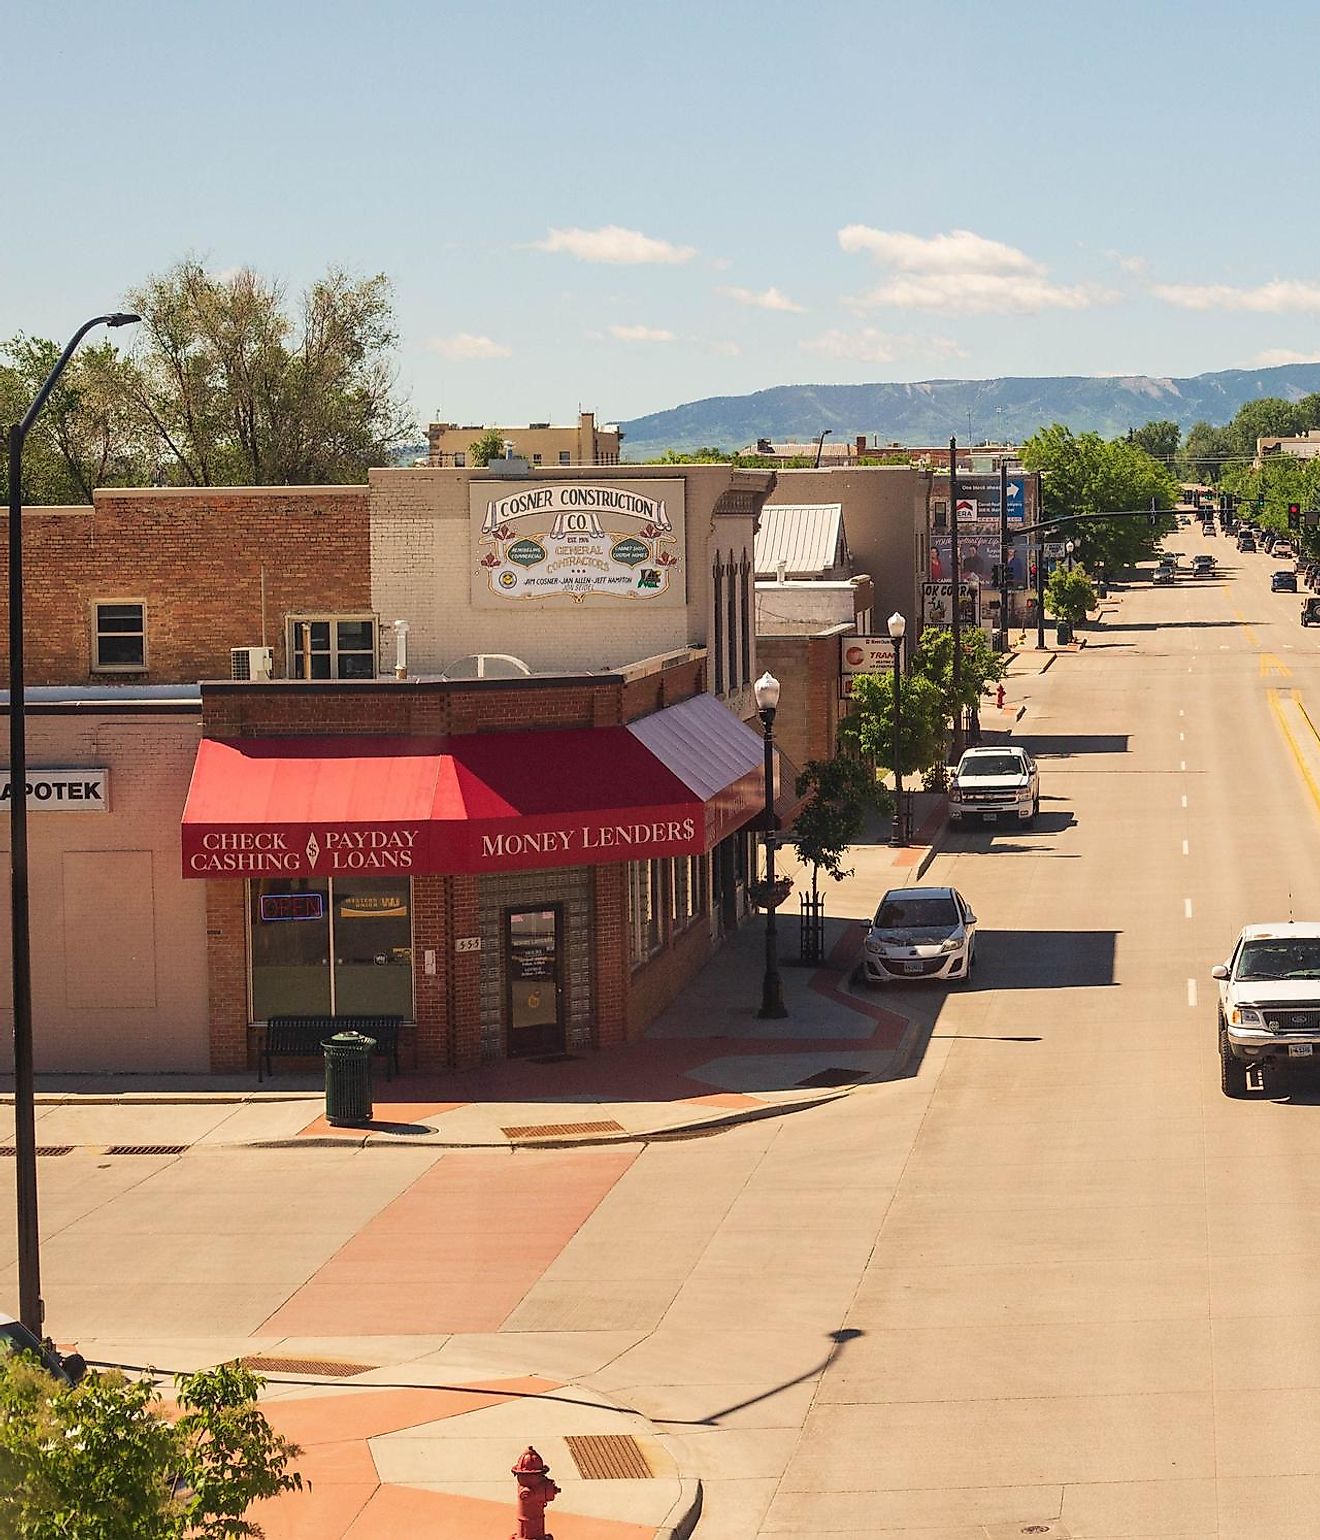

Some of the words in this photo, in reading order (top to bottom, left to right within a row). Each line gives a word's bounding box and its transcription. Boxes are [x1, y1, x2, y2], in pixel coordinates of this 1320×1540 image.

[500, 490, 554, 517] COSNER
[560, 489, 653, 518] CONSTRUCTION
[567, 514, 588, 530] CO.
[555, 546, 603, 554] GENERAL
[546, 556, 609, 574] CONTRACTORS
[926, 585, 938, 597] OK
[202, 833, 288, 850] CHECK
[325, 830, 419, 849] PAYDAY
[481, 830, 575, 857] MONEY
[190, 853, 300, 871] CASHING
[332, 850, 413, 869] LOANS
[265, 898, 320, 917] OPEN
